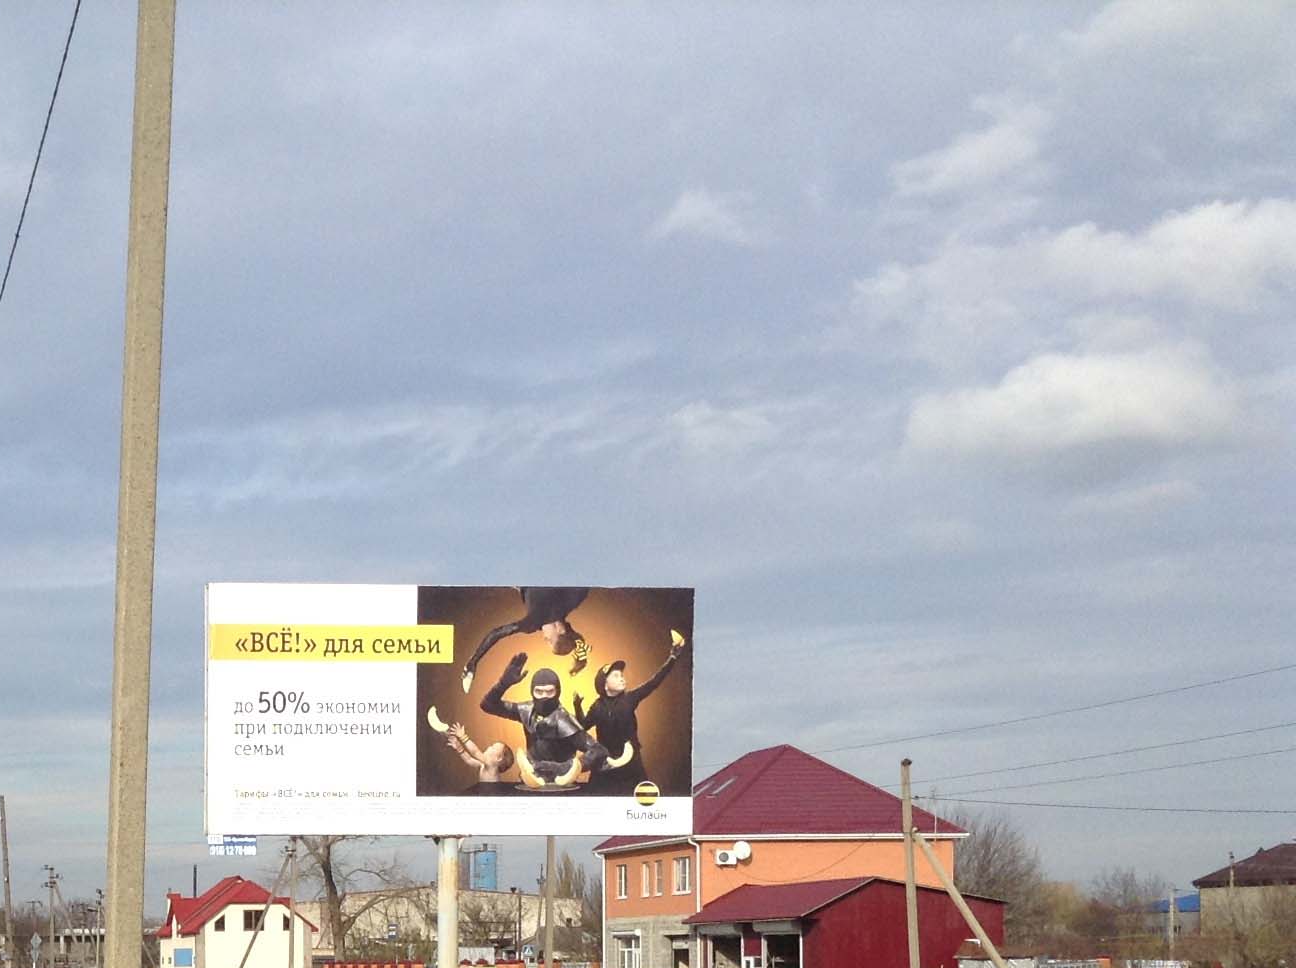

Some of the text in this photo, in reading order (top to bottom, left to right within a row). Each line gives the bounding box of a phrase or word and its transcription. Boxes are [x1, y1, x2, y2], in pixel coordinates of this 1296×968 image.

[235, 627, 441, 657] «ВСЁ!» для семьи
[233, 691, 401, 715] до 50% экономии
[234, 723, 393, 738] при подключении
[234, 743, 284, 756] семьи
[626, 809, 667, 820] Билайн
